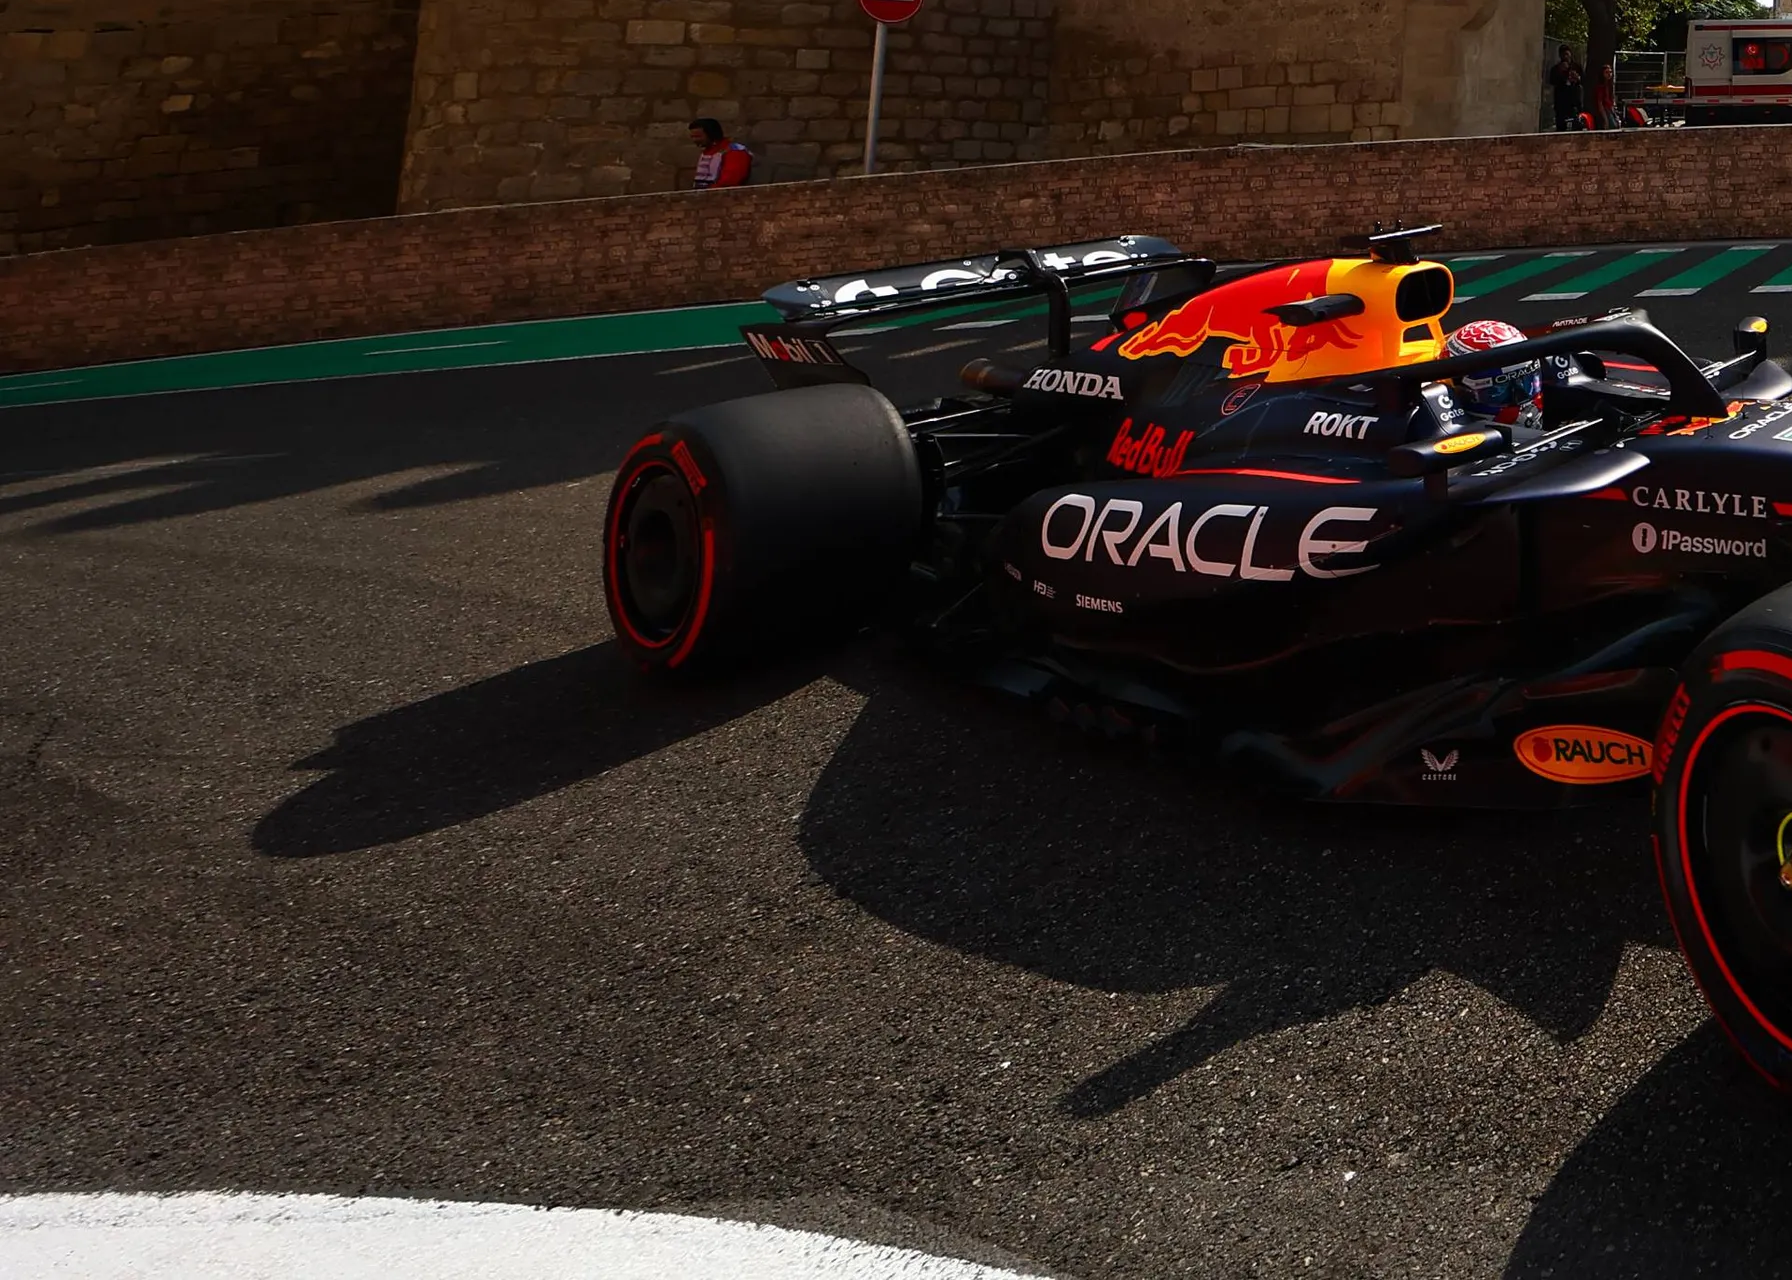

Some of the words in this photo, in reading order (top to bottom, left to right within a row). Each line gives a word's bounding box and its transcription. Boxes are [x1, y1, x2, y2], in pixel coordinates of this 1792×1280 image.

[747, 332, 817, 363] Mobil
[1022, 368, 1124, 400] HONDA
[1495, 358, 1540, 384] ORACLE
[1557, 367, 1579, 380] Gate
[1303, 411, 1379, 440] ROKT
[1440, 407, 1465, 422] Gate
[1632, 486, 1767, 518] CARLYLE
[1041, 493, 1381, 581] ORACLE
[1661, 529, 1767, 557] 1Password
[1076, 594, 1123, 613] SIEMENS
[1554, 737, 1646, 766] RAUCH
[1421, 773, 1457, 781] CASTORE
